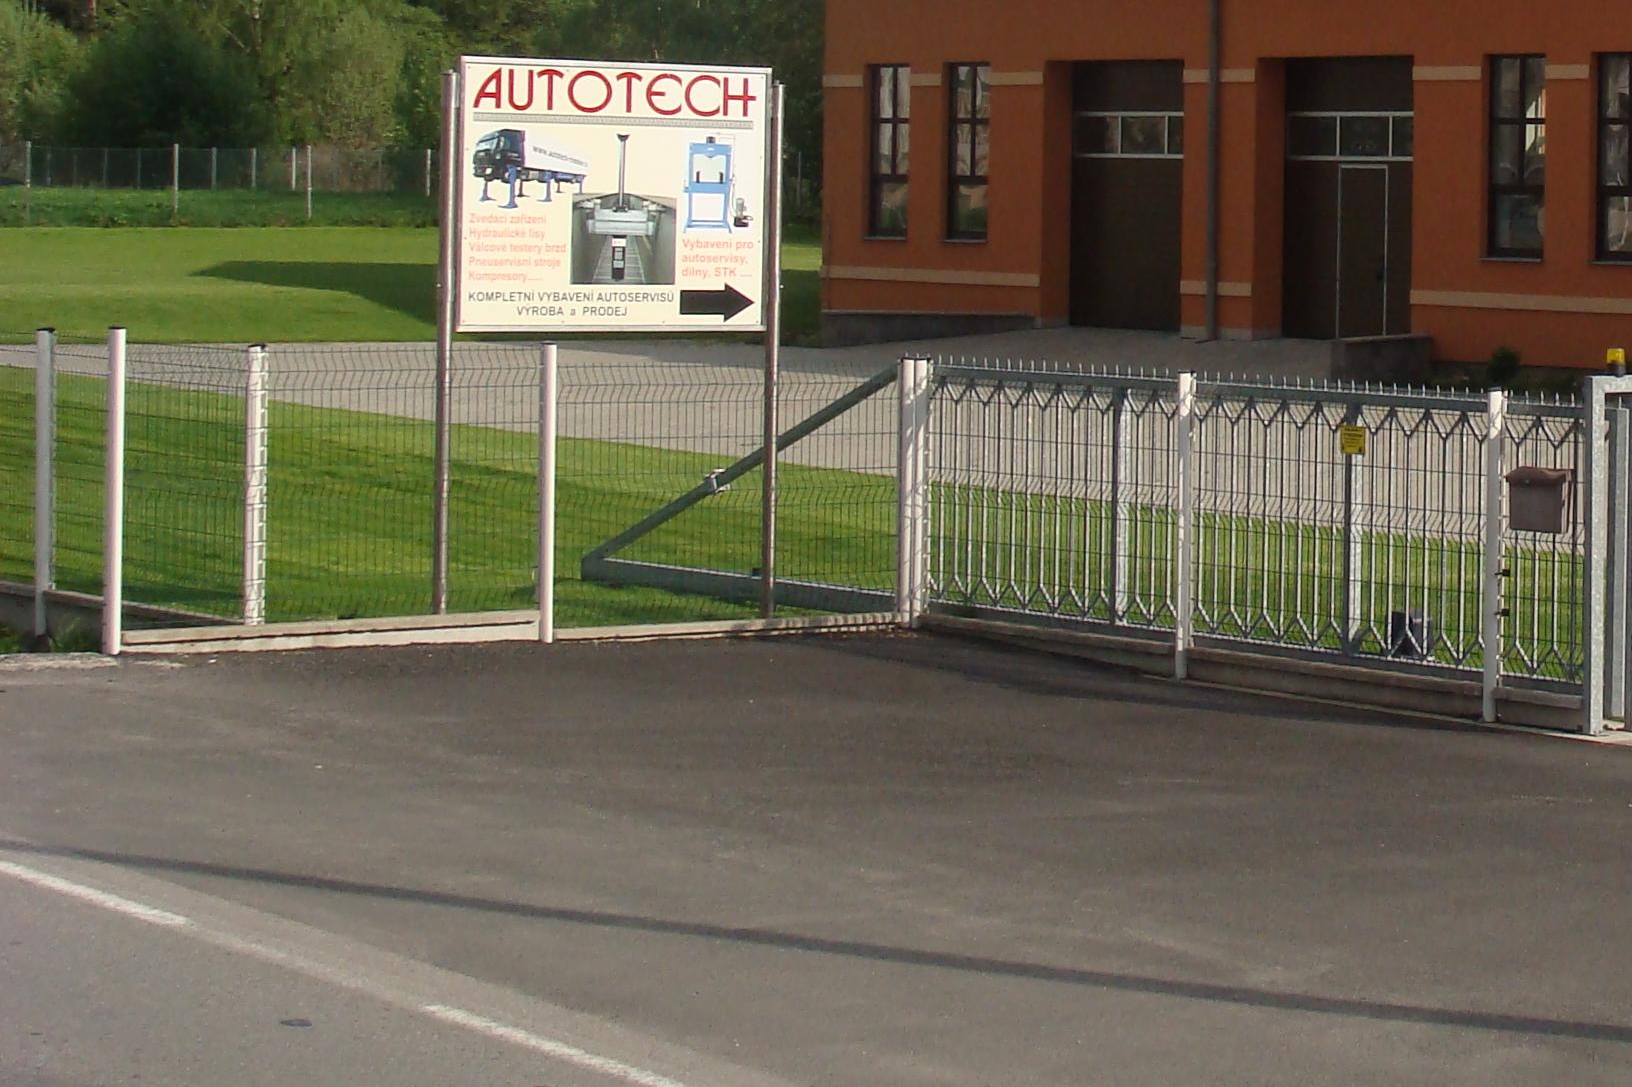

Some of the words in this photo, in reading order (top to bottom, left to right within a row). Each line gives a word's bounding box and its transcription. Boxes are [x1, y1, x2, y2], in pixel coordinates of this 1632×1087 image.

[472, 67, 757, 118] AUTOTECH
[545, 242, 567, 253] brzd
[735, 240, 754, 251] pro
[714, 266, 737, 277] STK
[570, 308, 576, 316] a
[582, 306, 628, 316] PRODEJ
